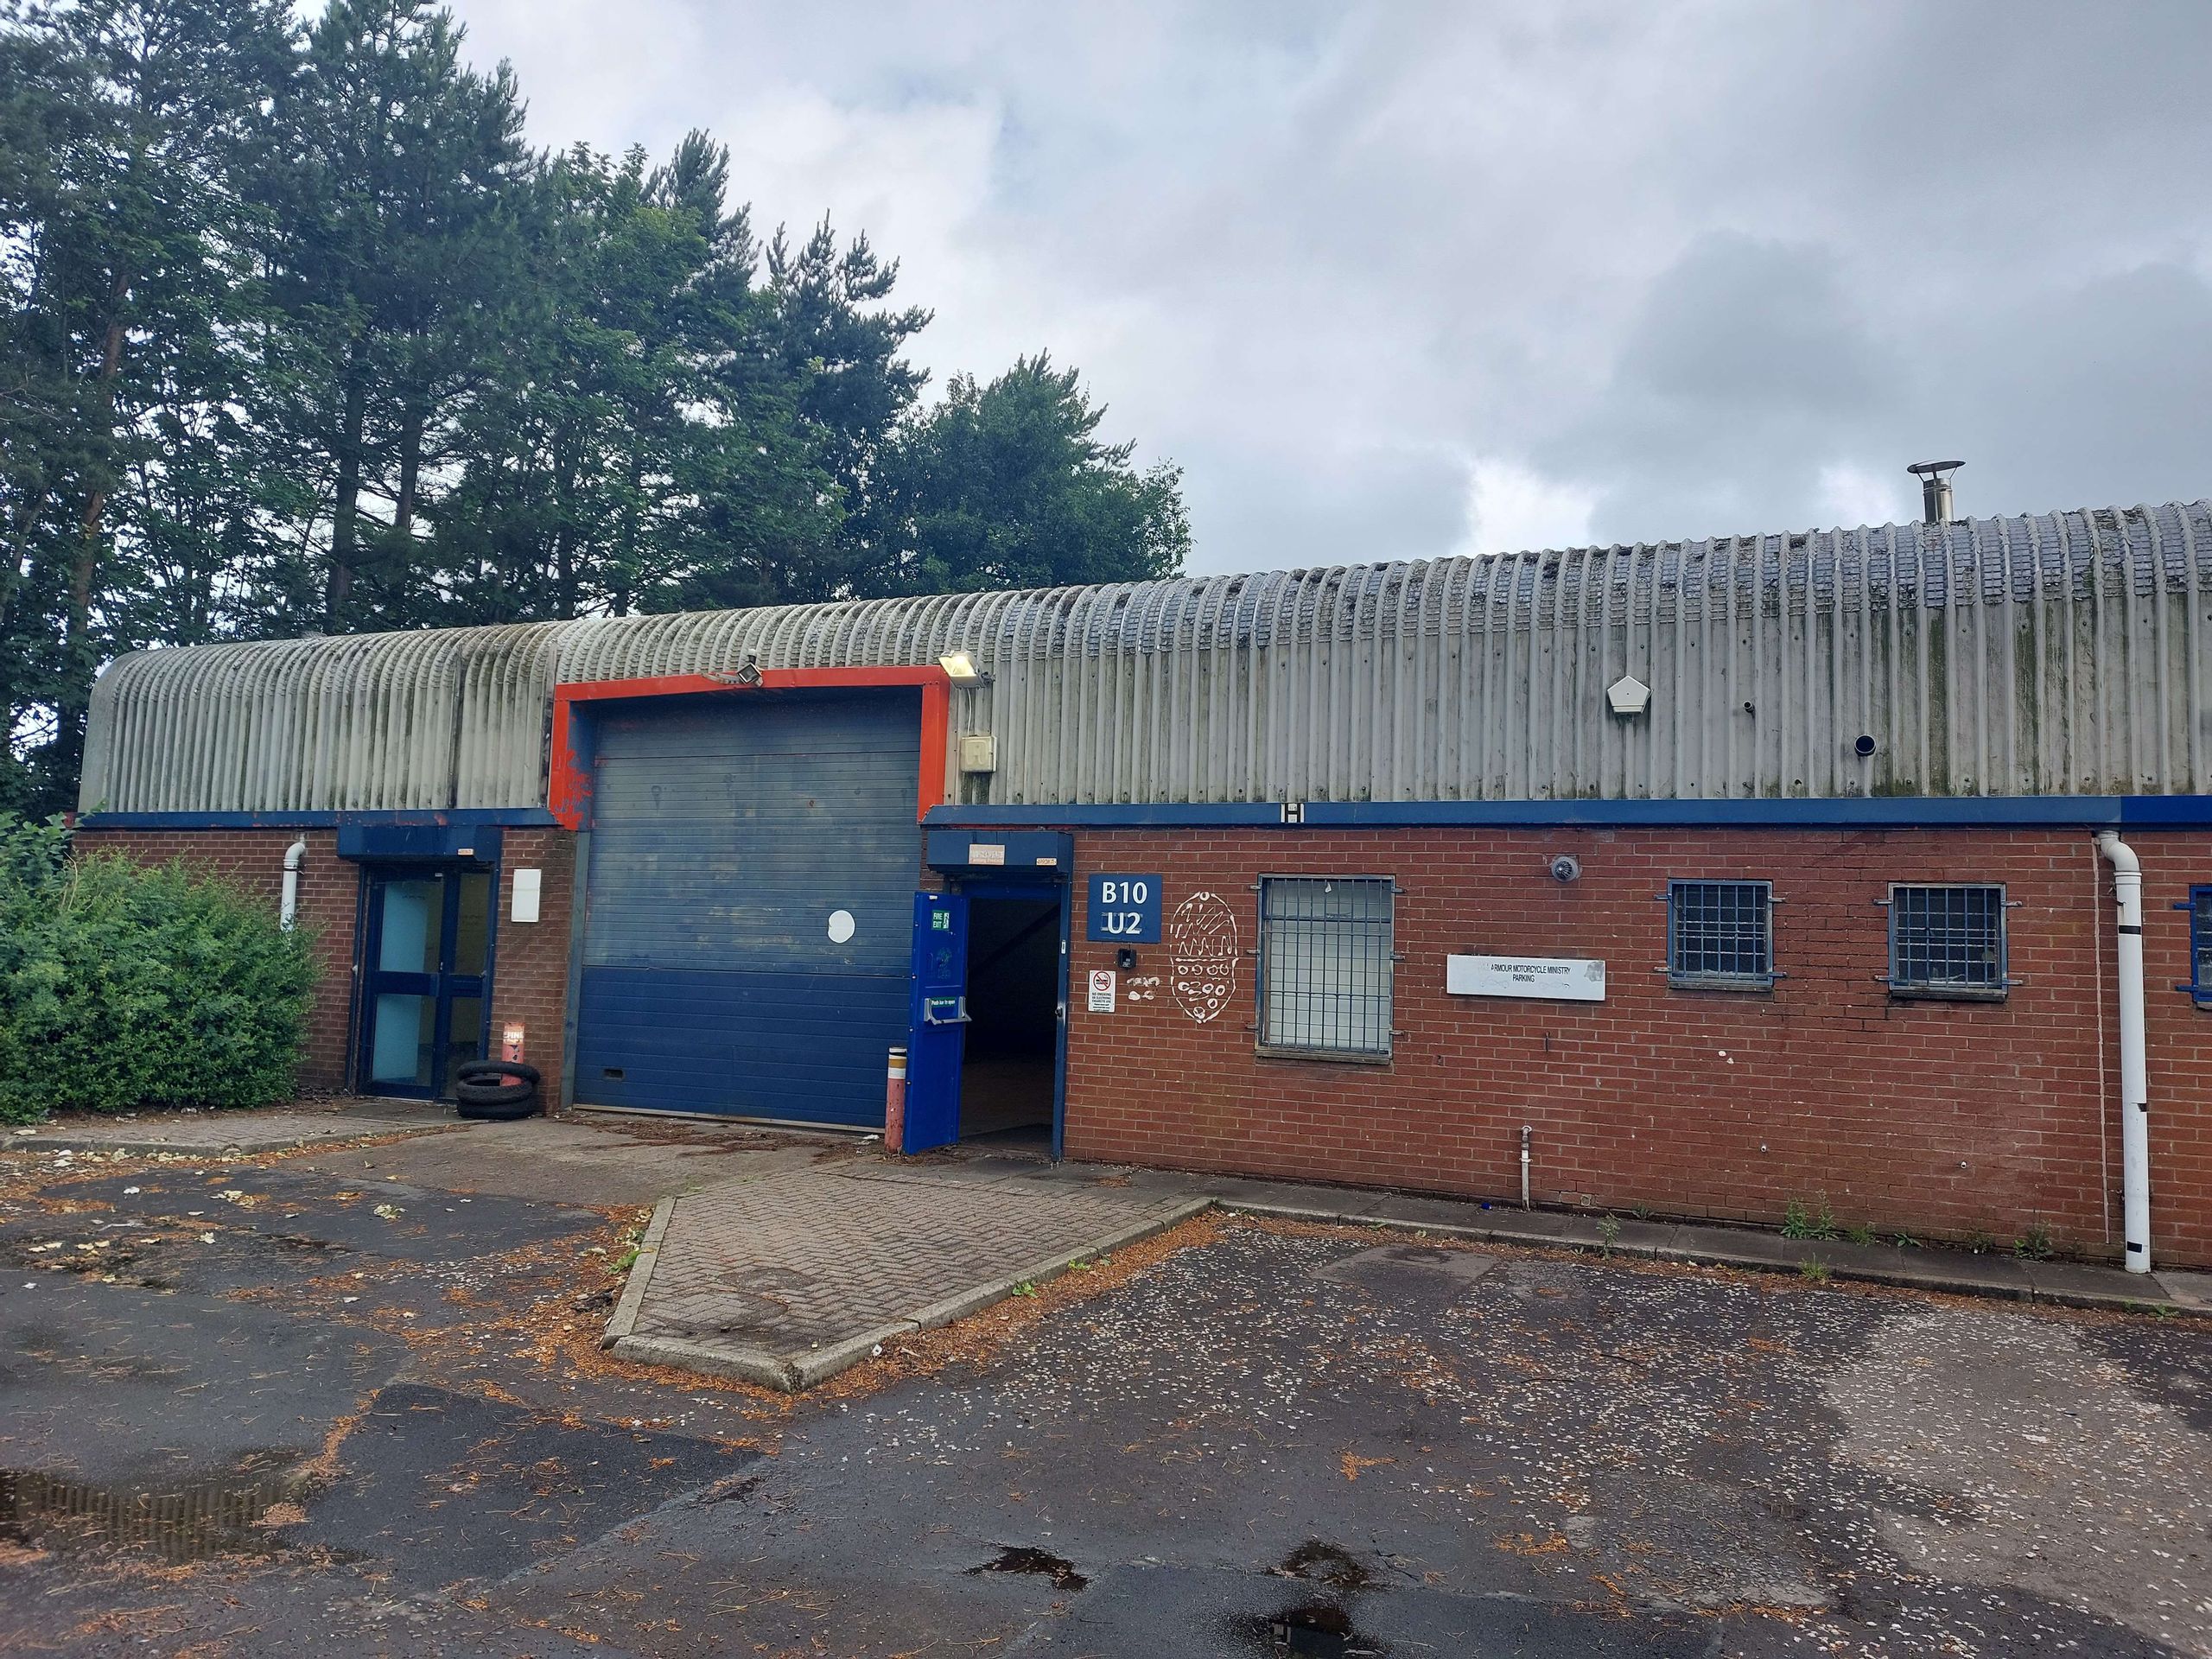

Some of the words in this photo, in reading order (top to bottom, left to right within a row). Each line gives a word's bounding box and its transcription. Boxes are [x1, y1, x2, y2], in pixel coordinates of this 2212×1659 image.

[1102, 881, 1147, 904] B10
[1108, 912, 1141, 934] U2
[1491, 963, 1512, 973] ARMOUR
[1513, 964, 1547, 974] MOTORCYCLE
[1547, 966, 1571, 975] MINISTRY
[1512, 974, 1535, 982] PARKING
